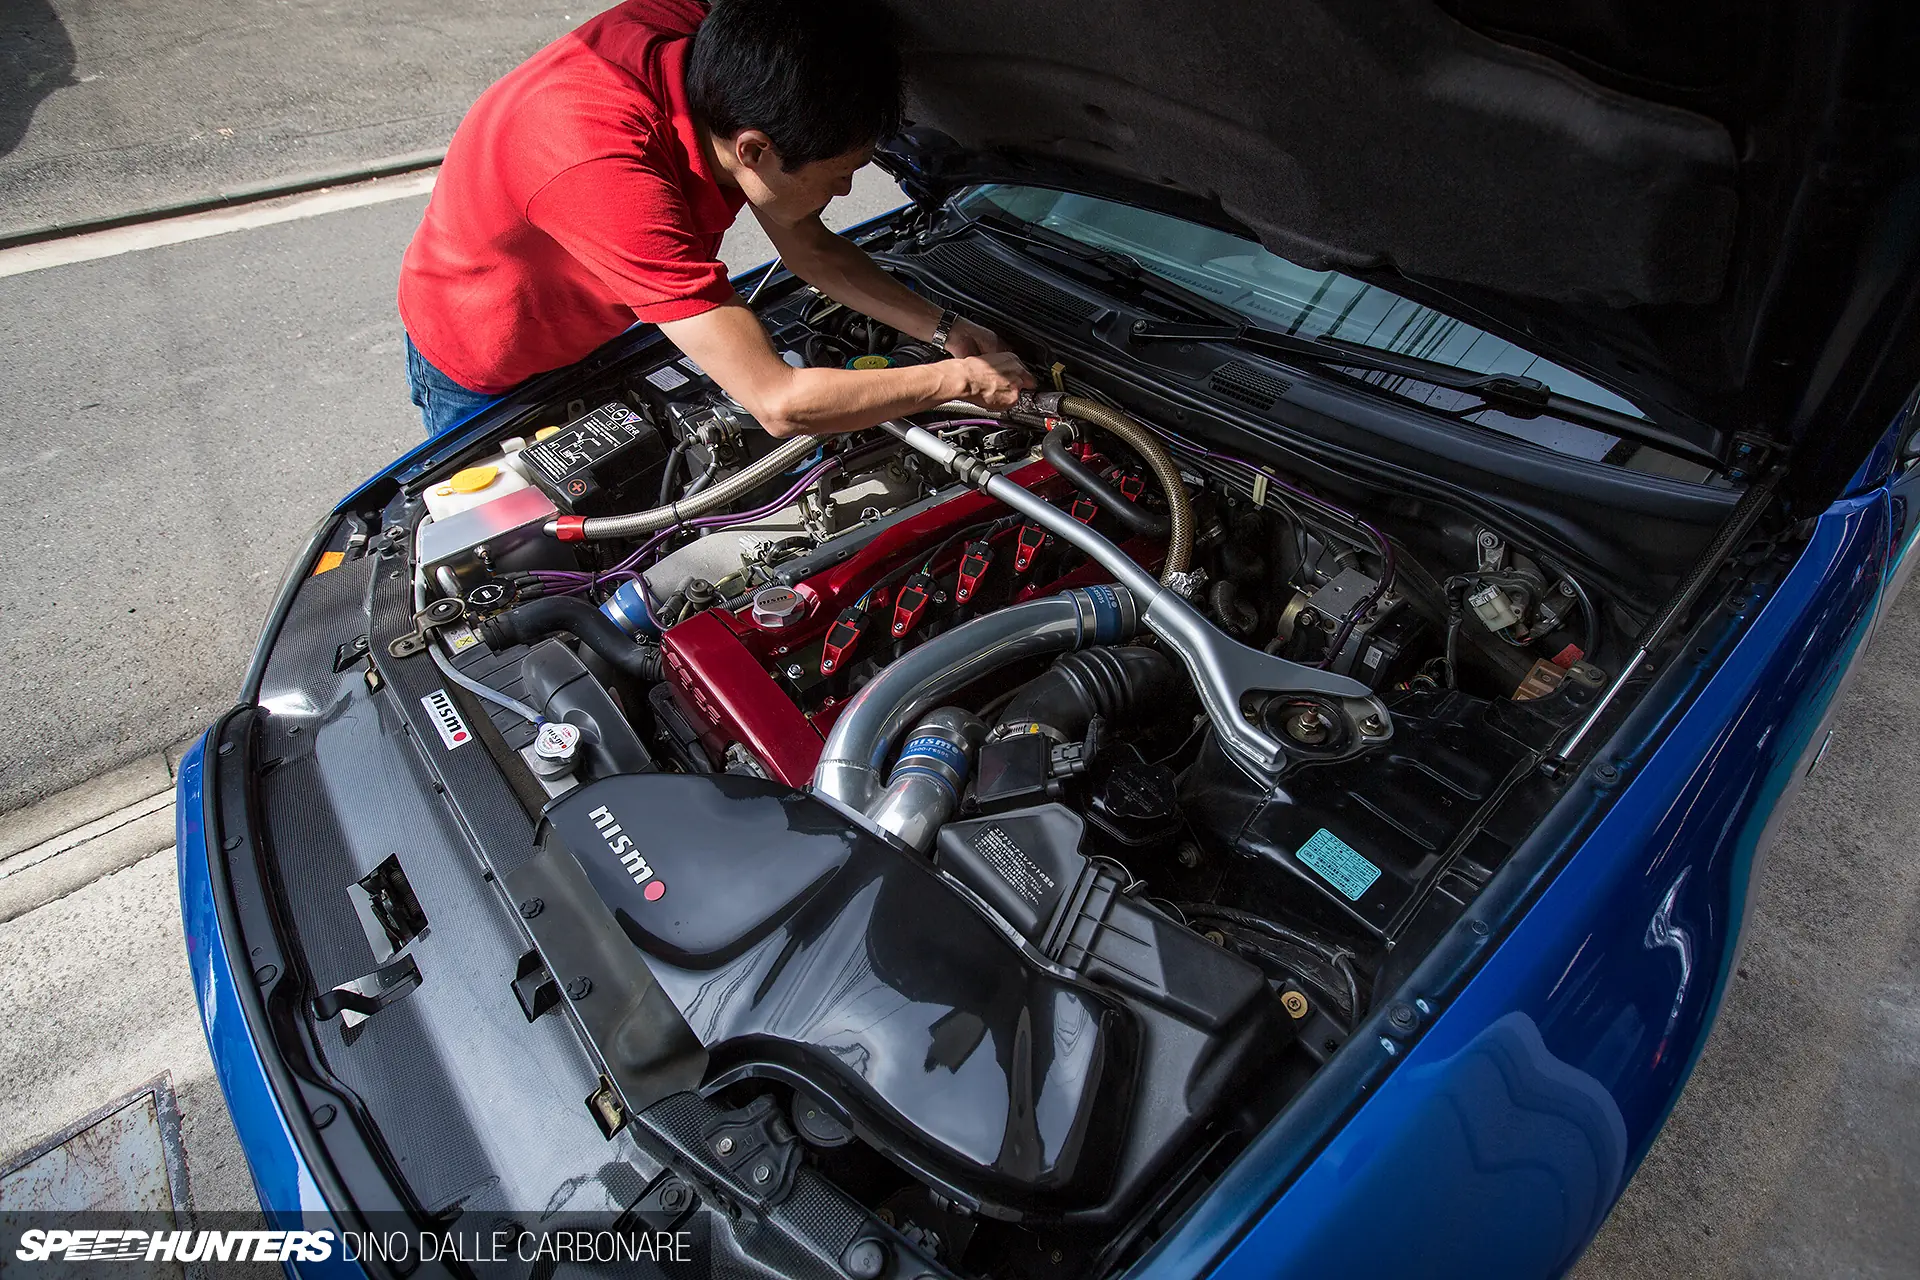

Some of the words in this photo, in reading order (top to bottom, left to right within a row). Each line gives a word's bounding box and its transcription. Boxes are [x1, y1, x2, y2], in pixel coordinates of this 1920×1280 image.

[430, 692, 467, 742] nismo
[547, 728, 567, 750] nismo
[909, 738, 959, 754] nismo
[587, 804, 667, 902] nismo
